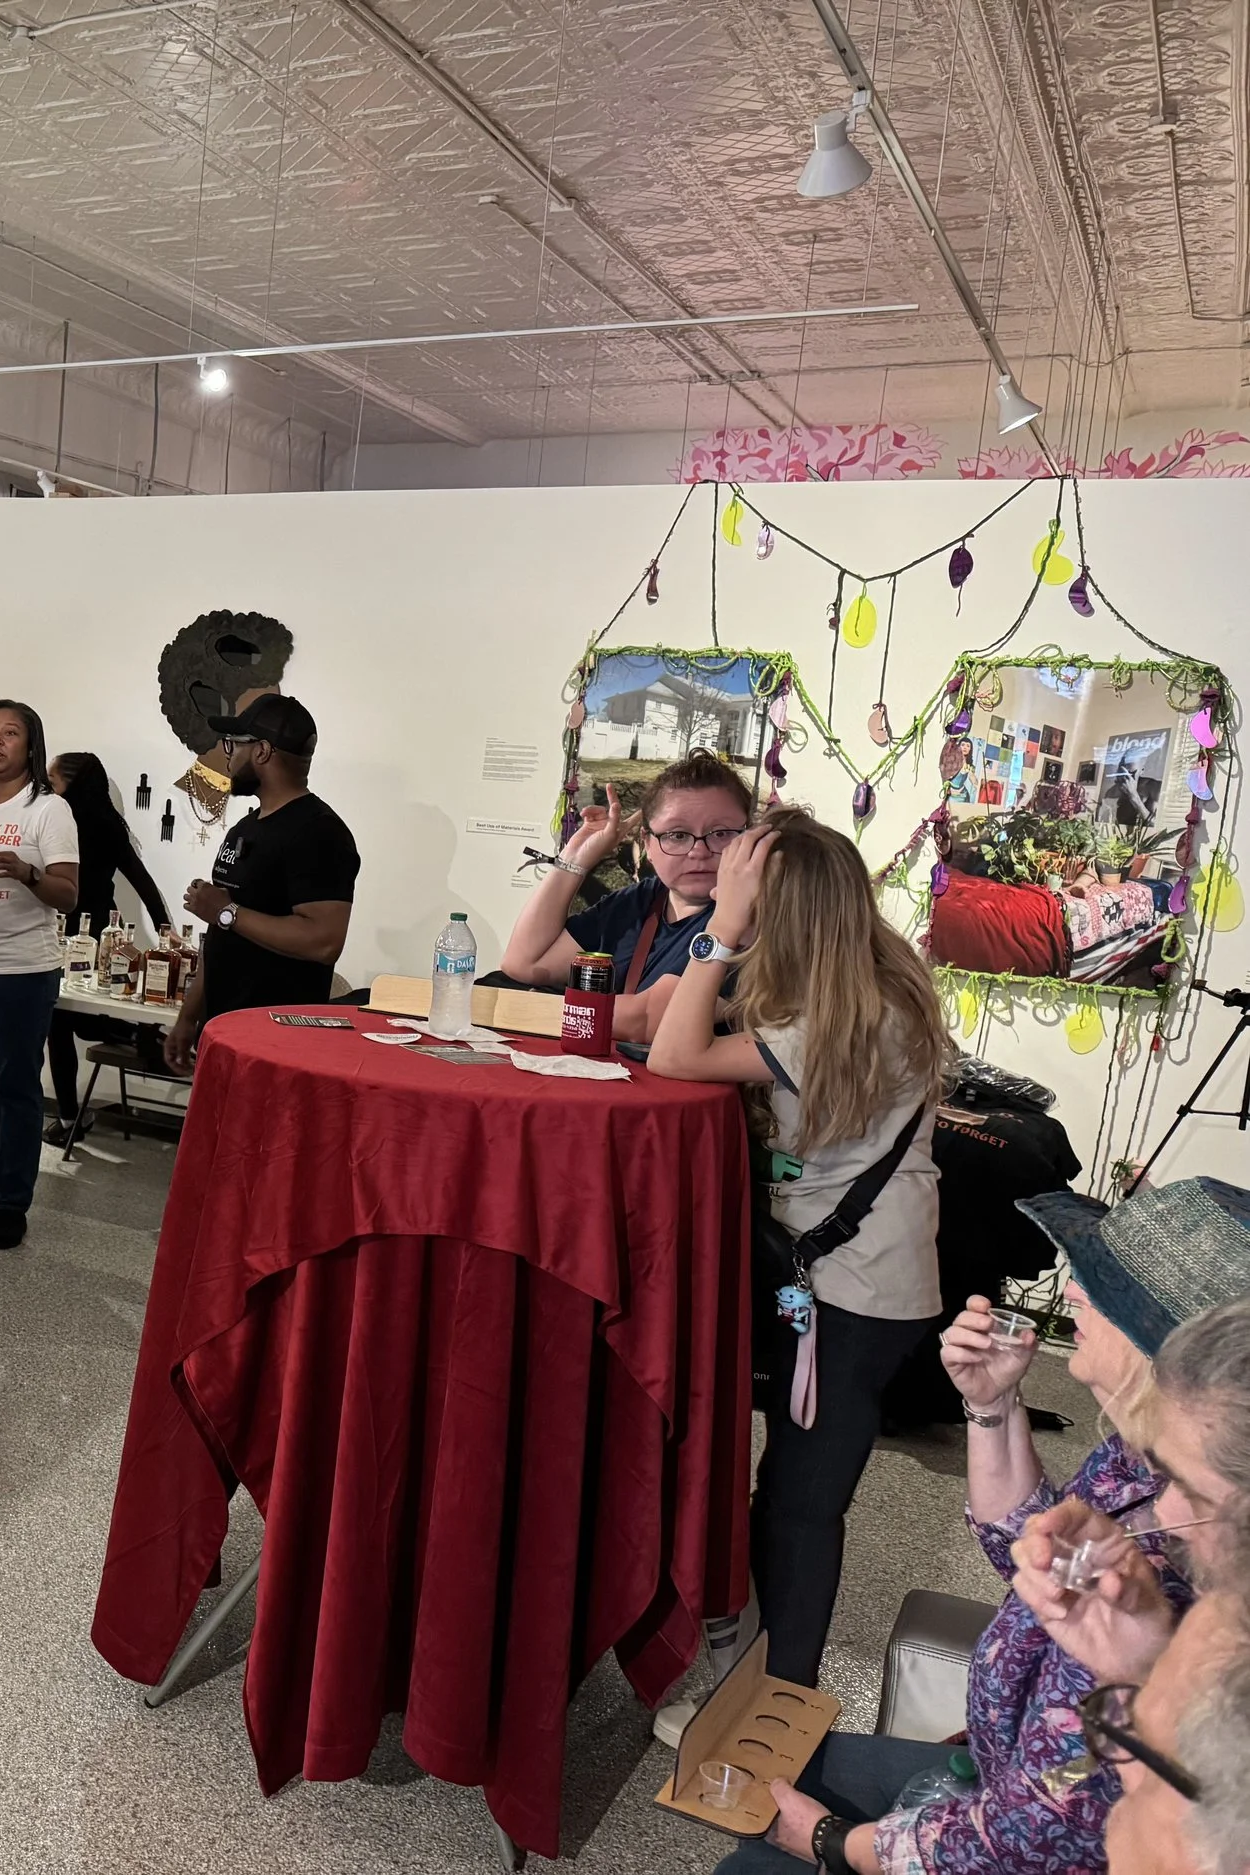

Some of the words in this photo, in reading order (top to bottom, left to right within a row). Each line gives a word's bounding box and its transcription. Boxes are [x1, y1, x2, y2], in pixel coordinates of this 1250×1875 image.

[1111, 731, 1166, 752] blond
[3, 823, 18, 834] TO
[952, 1123, 1009, 1149] FORGET
